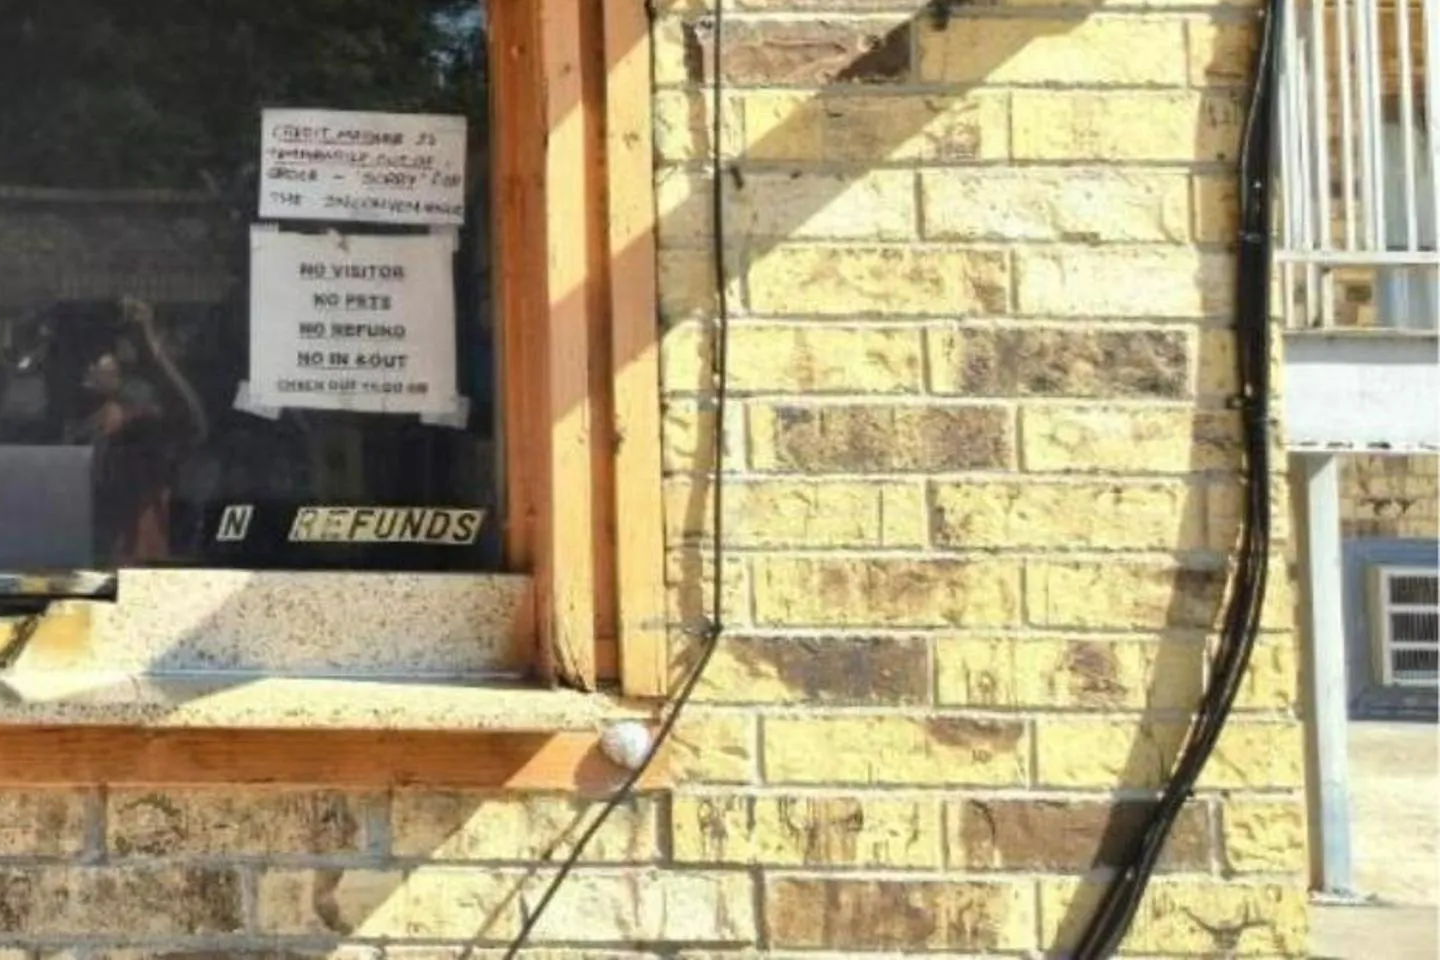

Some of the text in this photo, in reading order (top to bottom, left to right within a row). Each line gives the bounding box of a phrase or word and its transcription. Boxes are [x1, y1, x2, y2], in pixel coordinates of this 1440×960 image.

[301, 263, 405, 279] NO VISITOR
[314, 293, 391, 310] NO PETS
[299, 322, 406, 339] NO REFUND
[298, 351, 324, 367] NO
